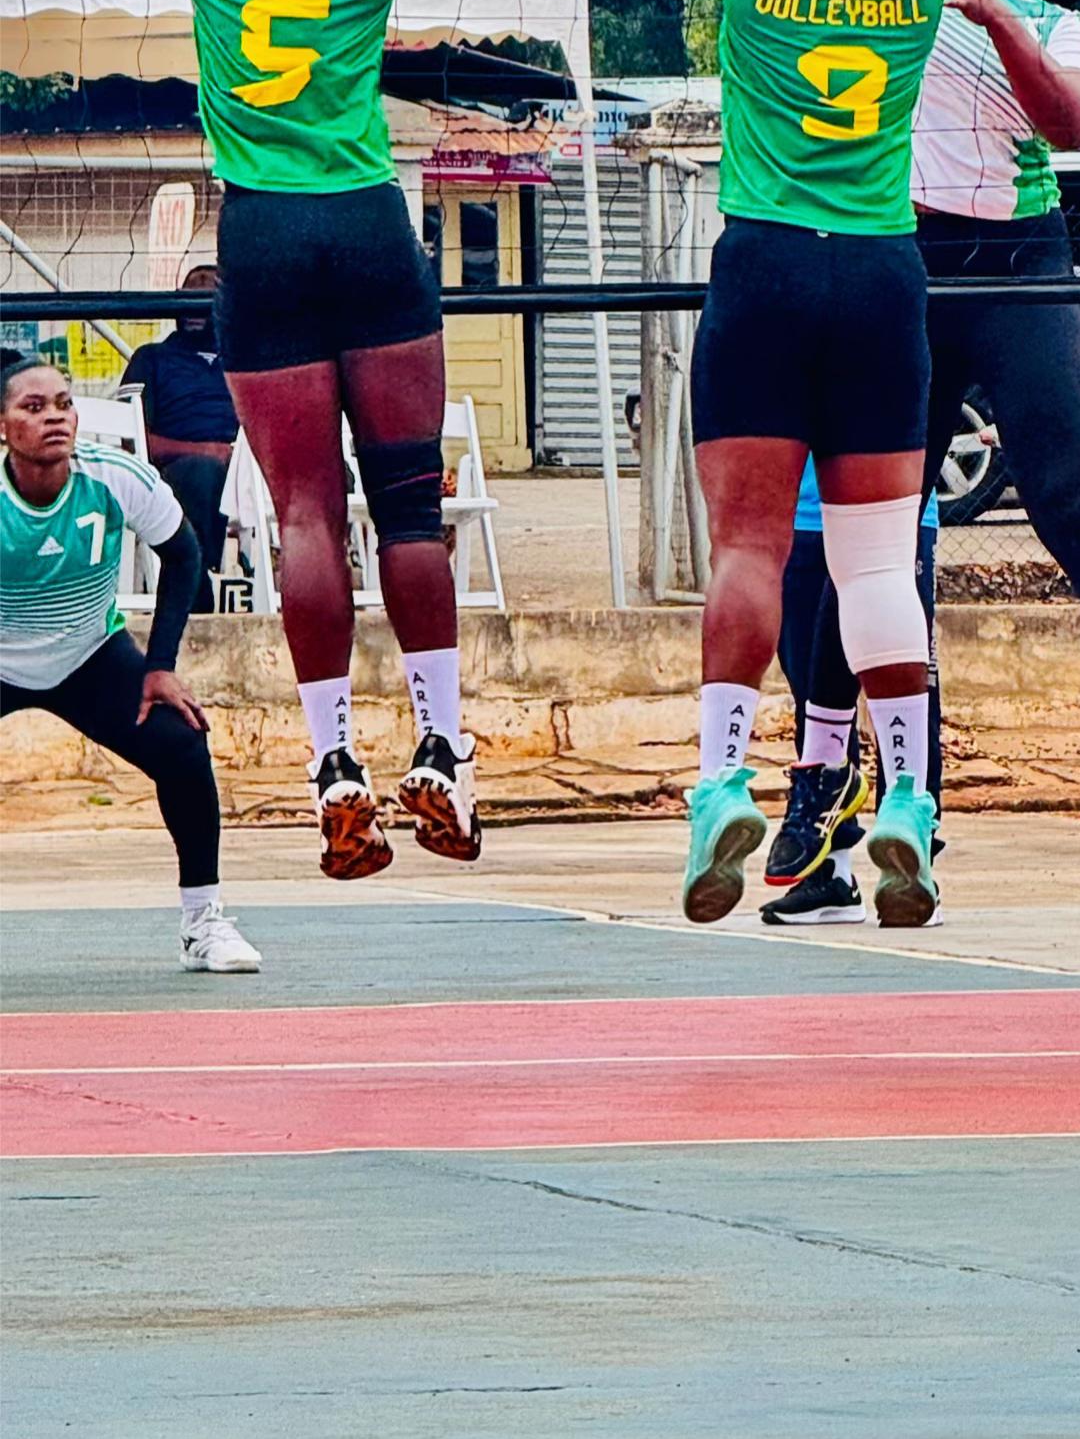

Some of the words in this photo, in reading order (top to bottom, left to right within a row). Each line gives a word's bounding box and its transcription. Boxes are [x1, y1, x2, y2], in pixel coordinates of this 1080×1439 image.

[797, 45, 889, 141] 9
[75, 511, 106, 567] 7
[335, 695, 347, 750] AR2
[412, 671, 434, 736] AR27
[725, 704, 744, 767] AR2
